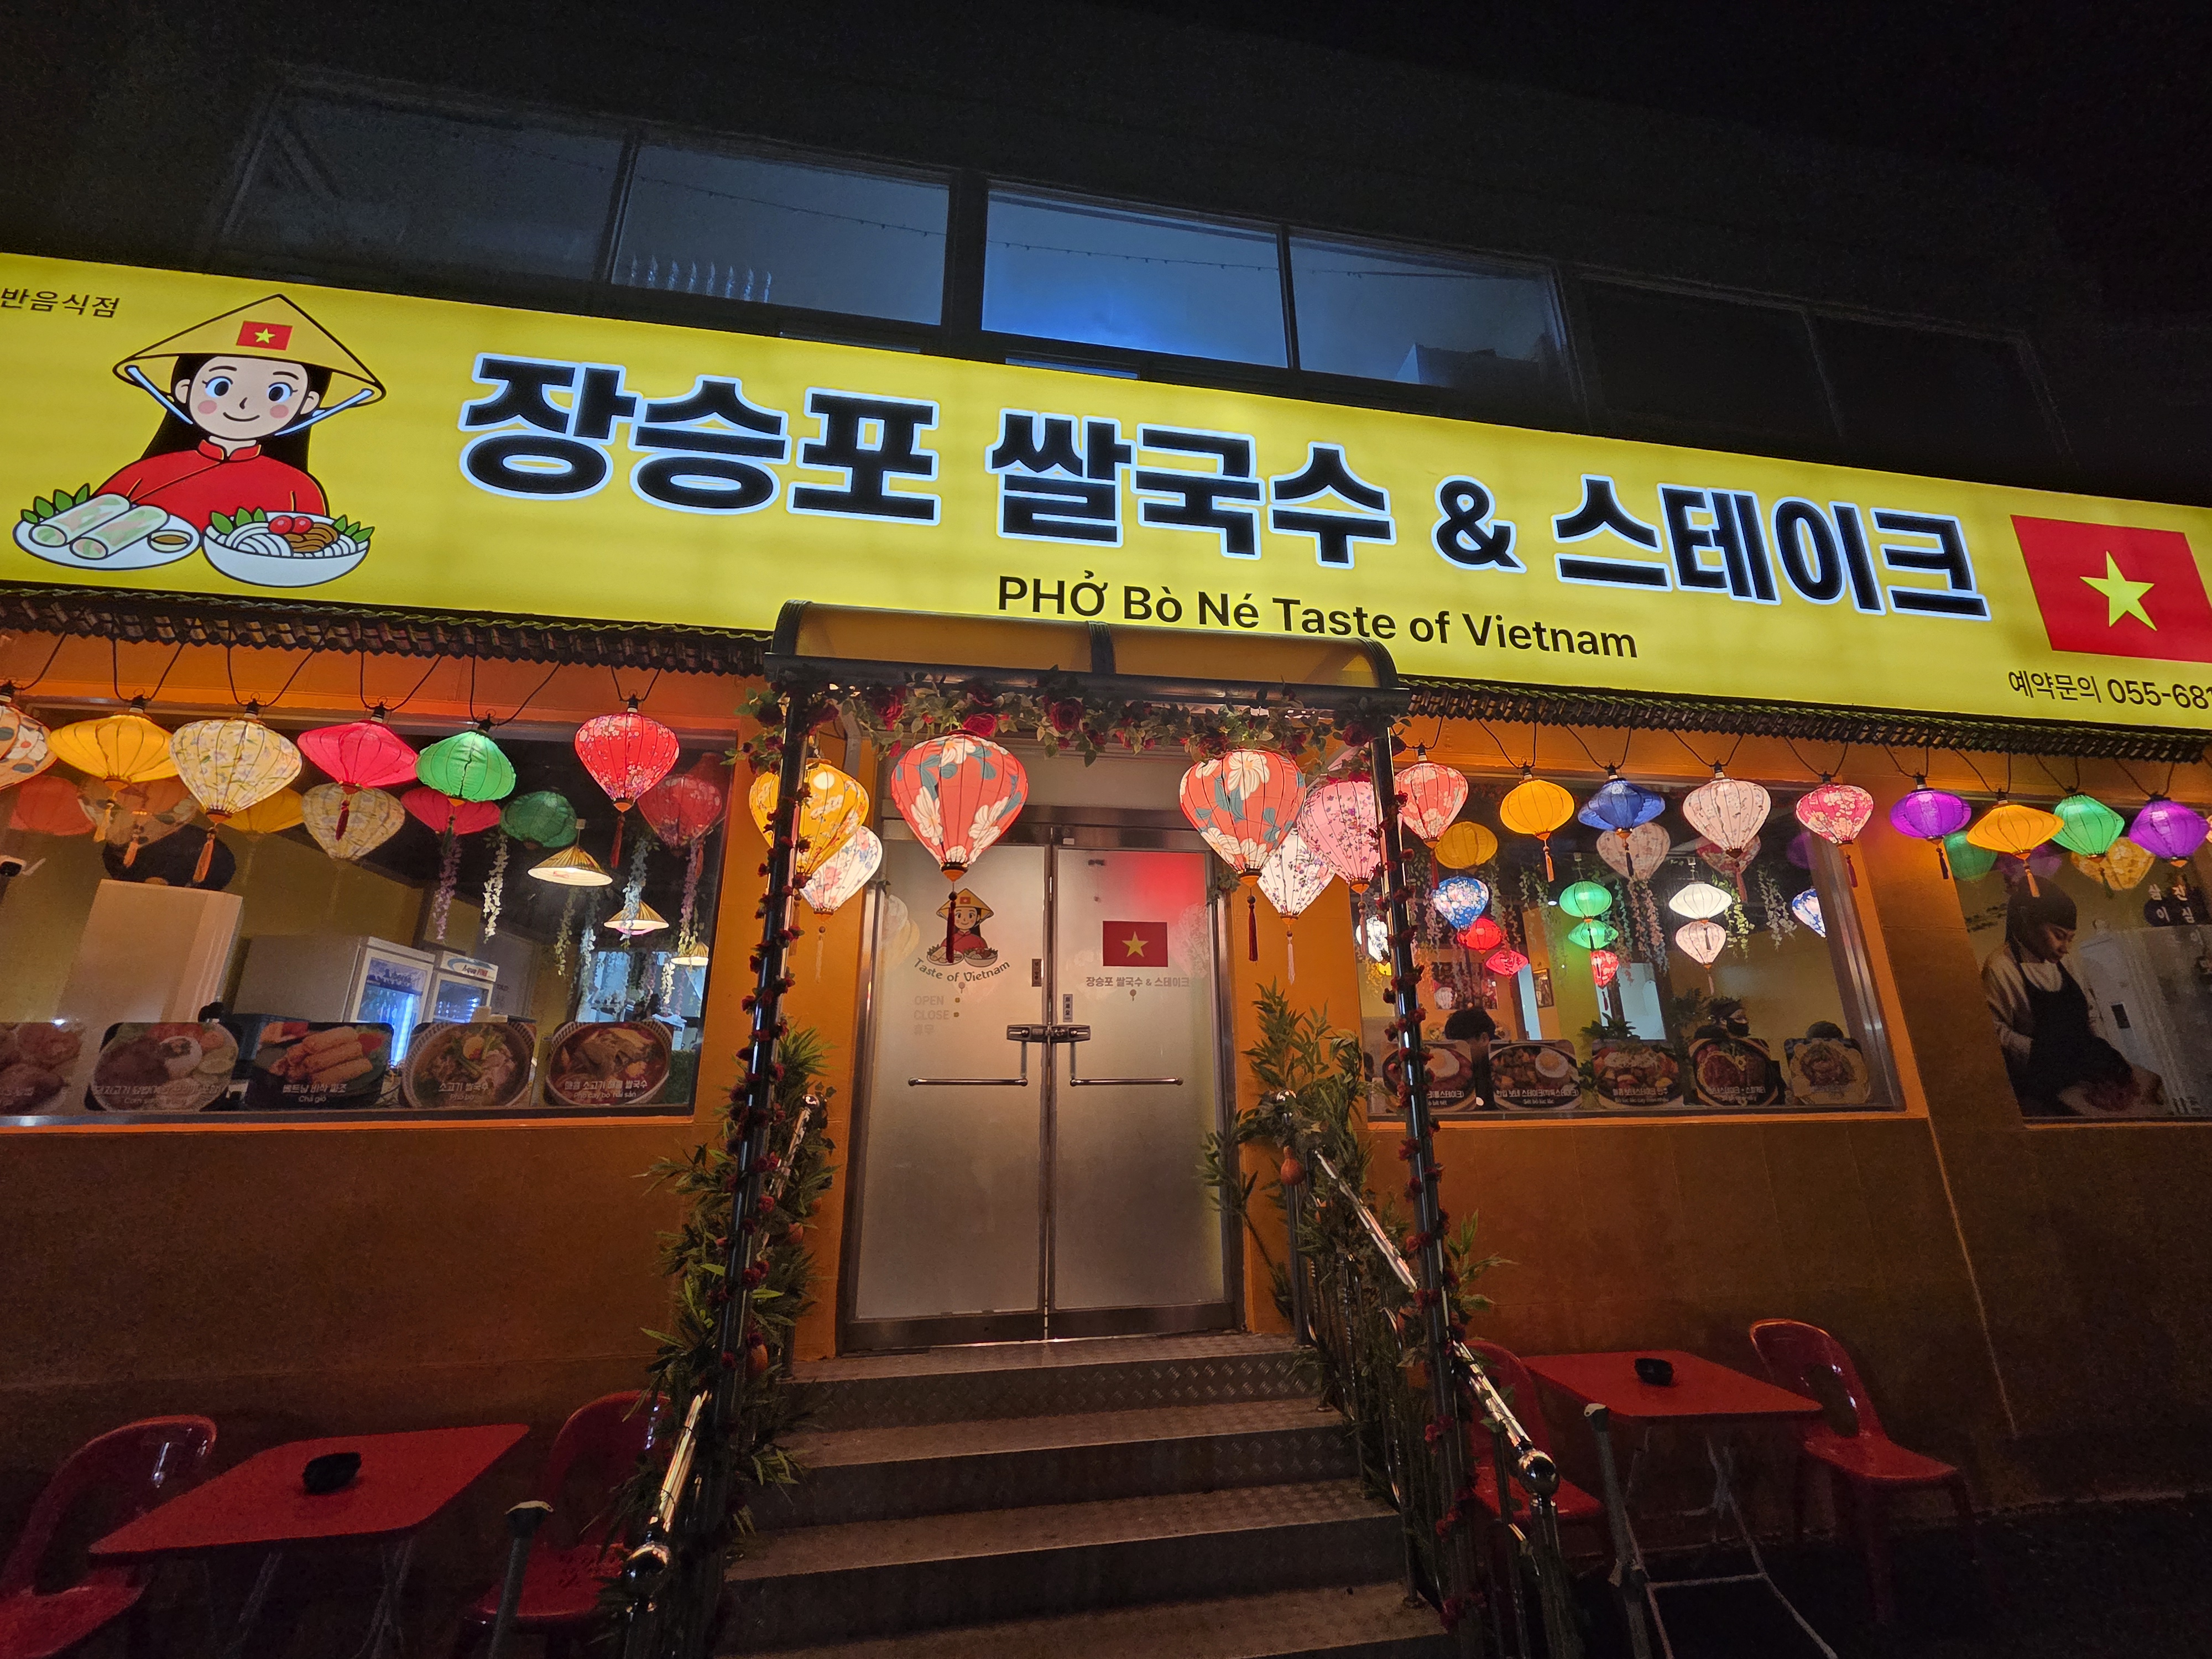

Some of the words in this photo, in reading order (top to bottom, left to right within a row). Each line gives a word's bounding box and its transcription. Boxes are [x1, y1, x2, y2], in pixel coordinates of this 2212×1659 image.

[0, 288, 121, 319] 반음식점
[459, 353, 940, 525] 장승포
[986, 408, 1395, 568] 쌀국수
[1433, 475, 1526, 571] &
[1552, 474, 1990, 620] 스테이크
[998, 570, 1109, 617] PHỞ
[1124, 585, 1183, 623] Bò
[1198, 591, 1260, 628] Né
[1272, 597, 1396, 639] Taste
[1409, 610, 1451, 644] of
[1462, 612, 1638, 659] Vietnam
[2008, 670, 2102, 703] 예약문의
[914, 957, 943, 979] Taste
[947, 972, 959, 982] of
[963, 961, 1010, 982] Vietnam
[1086, 976, 1114, 987] 장승포
[1116, 976, 1143, 987] 쌀국수
[1145, 978, 1152, 987] &
[1154, 977, 1190, 988] 스테이크
[914, 995, 945, 1005] OPEN
[914, 1010, 950, 1020] CLOSE
[438, 1082, 463, 1092] 소고기
[582, 1081, 606, 1090] 소고기
[625, 1080, 648, 1089] 쌀국수
